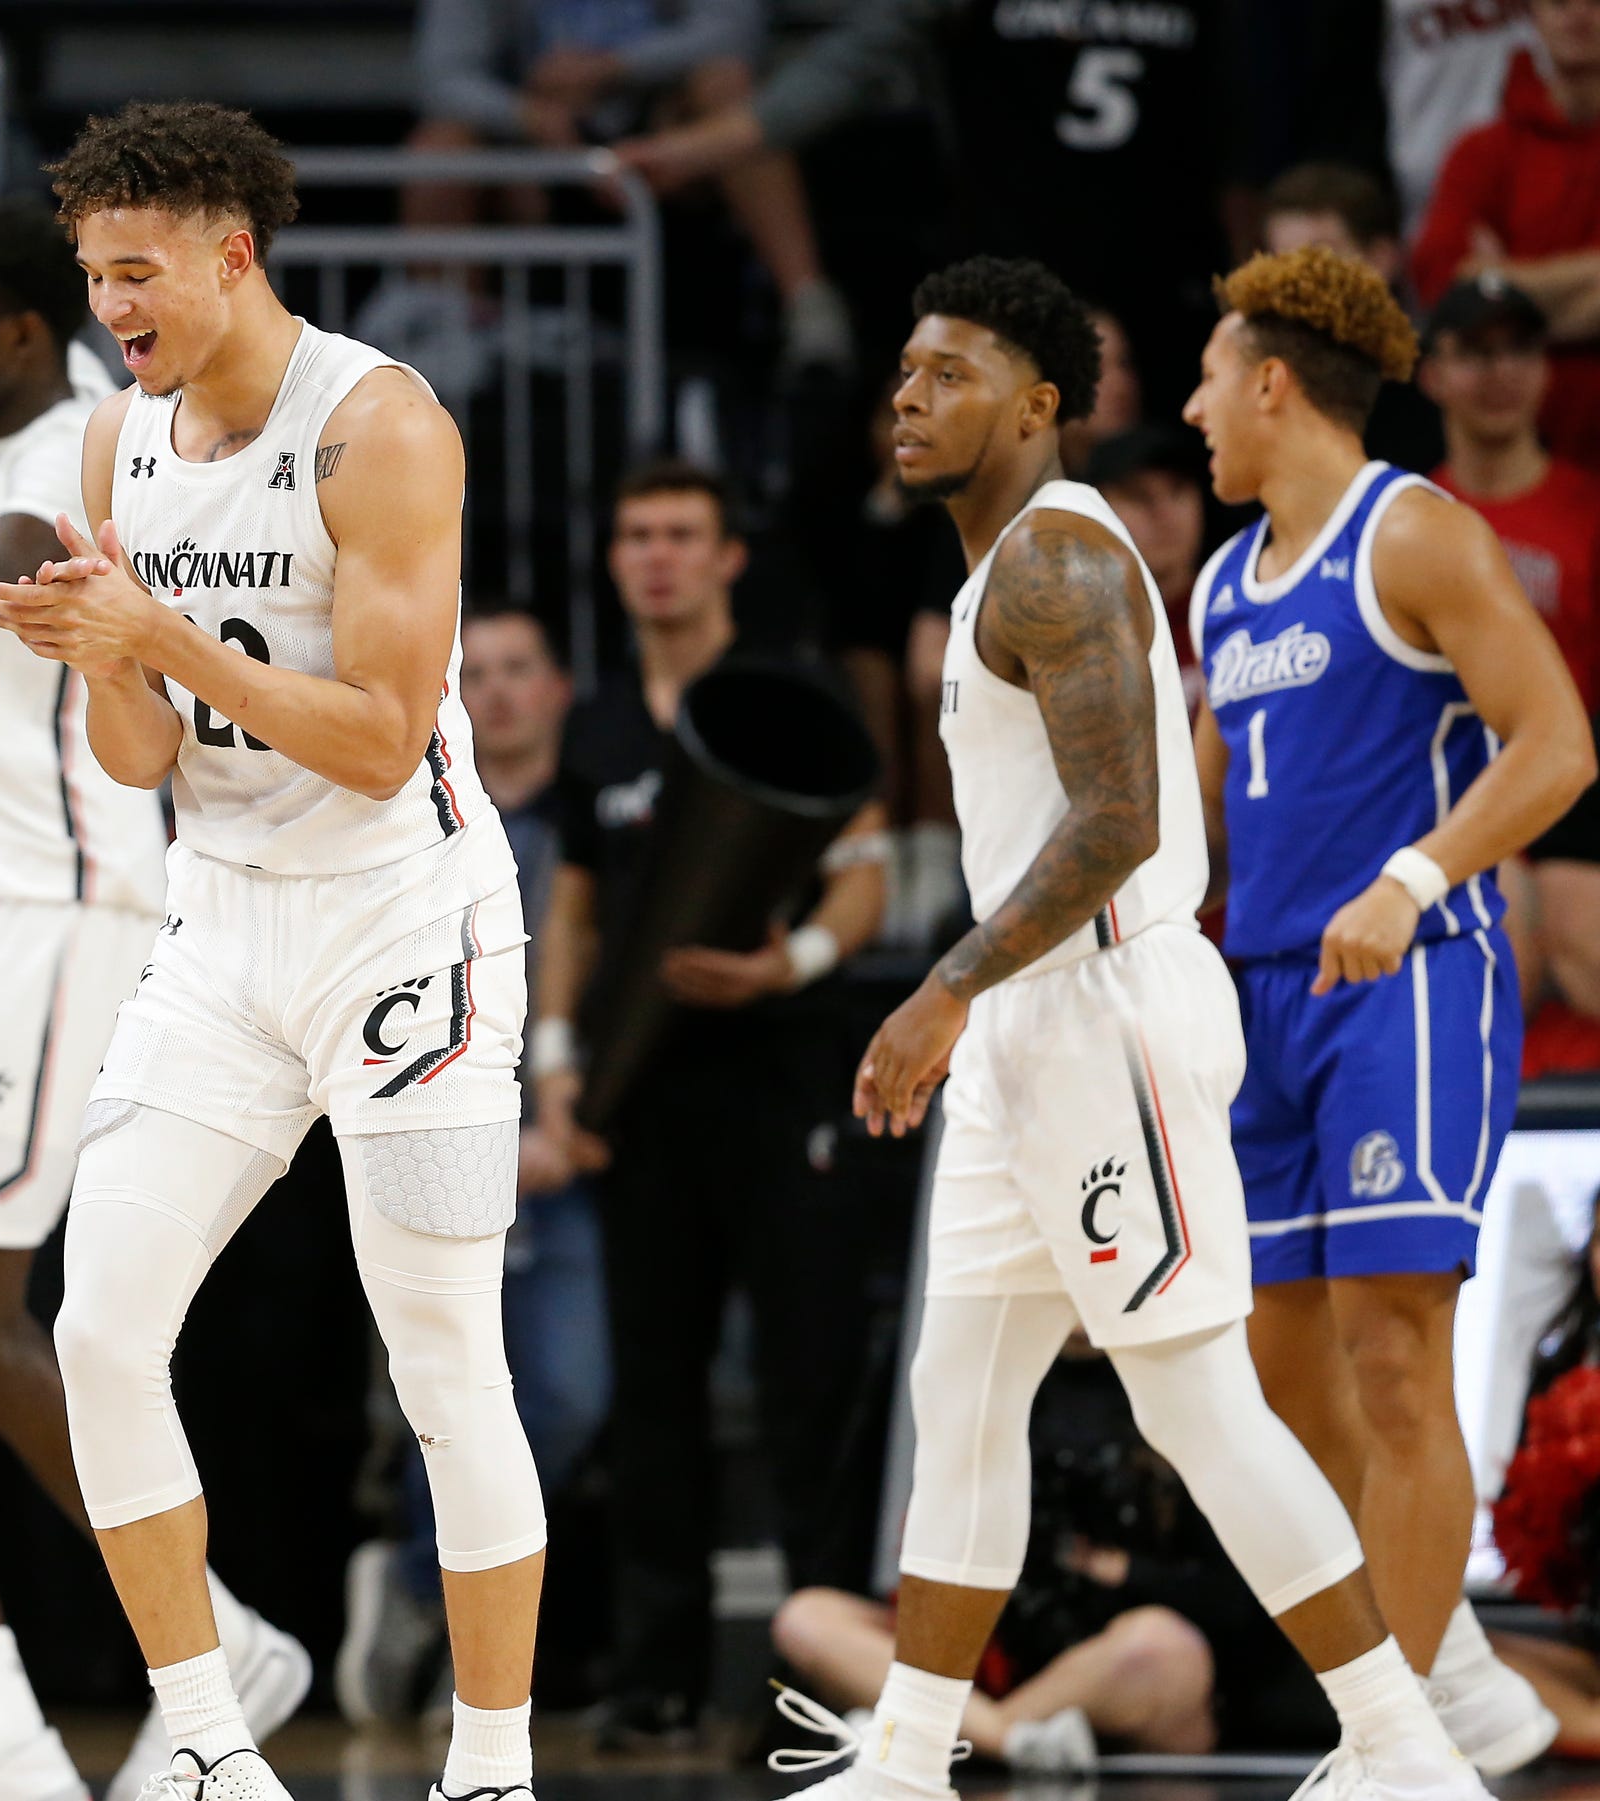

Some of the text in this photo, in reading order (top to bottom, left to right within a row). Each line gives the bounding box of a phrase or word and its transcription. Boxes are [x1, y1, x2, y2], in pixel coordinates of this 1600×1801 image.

[1055, 47, 1146, 150] 5
[133, 551, 294, 589] CINCINNATI
[1209, 624, 1330, 709] Drake
[1247, 708, 1269, 799] 1
